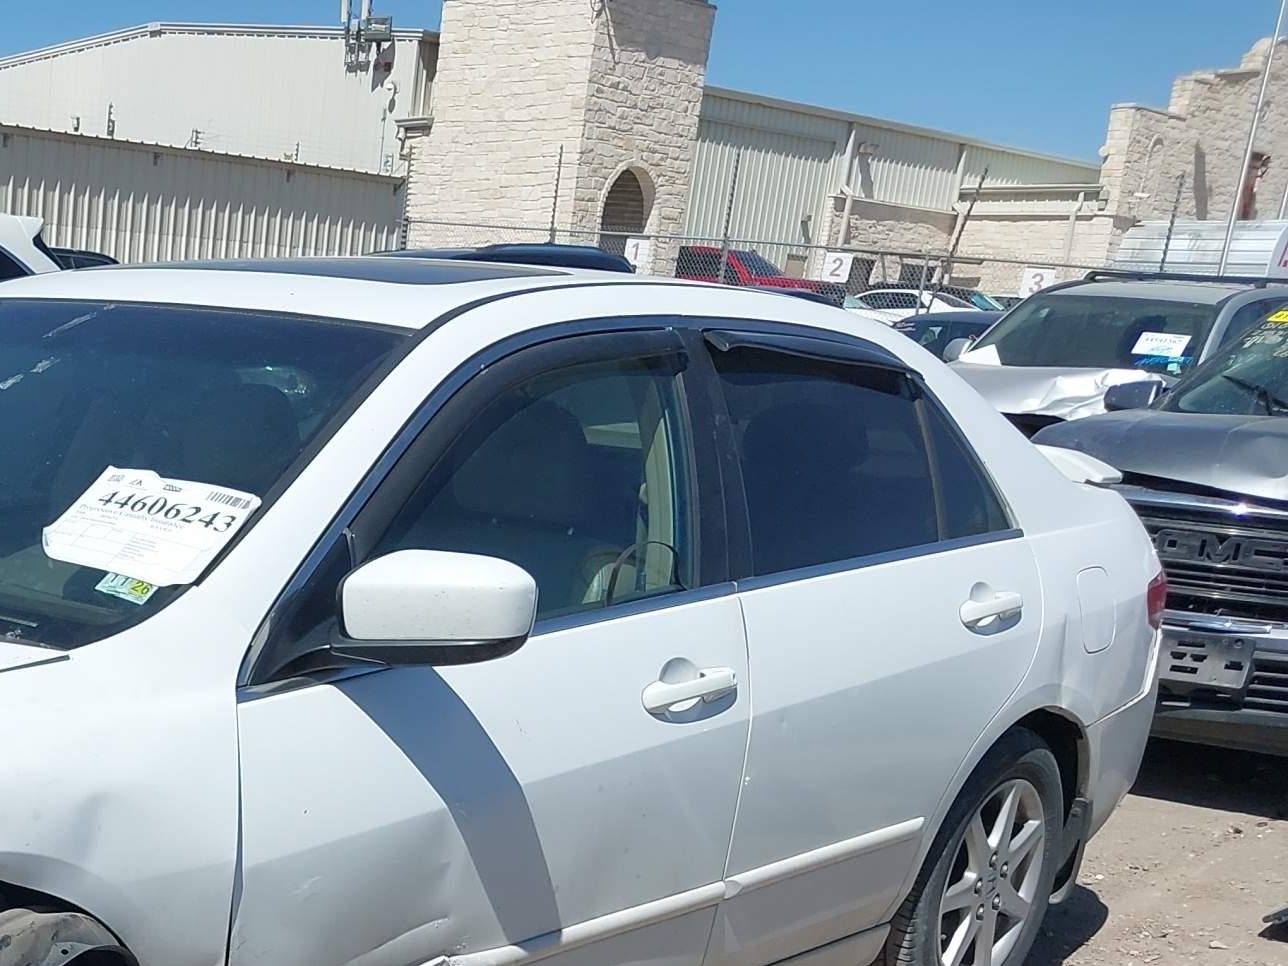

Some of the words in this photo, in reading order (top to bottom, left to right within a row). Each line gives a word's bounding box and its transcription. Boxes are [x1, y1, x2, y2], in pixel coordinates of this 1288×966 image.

[632, 242, 640, 260] 1
[829, 258, 844, 277] 2
[1028, 273, 1044, 293] 3
[98, 491, 237, 533] 44606243
[131, 580, 150, 595] 26
